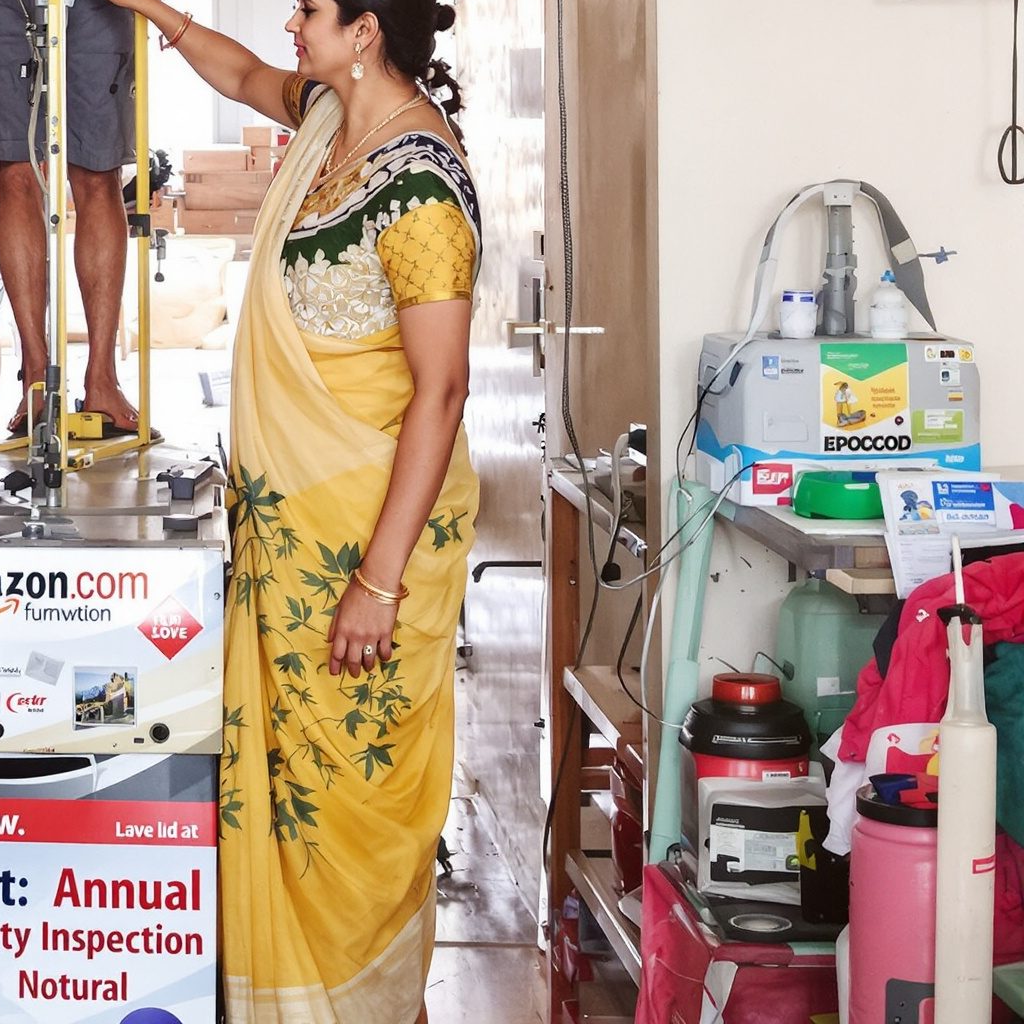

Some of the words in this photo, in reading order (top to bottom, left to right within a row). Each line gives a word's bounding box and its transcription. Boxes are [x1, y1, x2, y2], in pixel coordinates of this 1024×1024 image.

[115, 821, 154, 838] Lave
[53, 868, 201, 911] Annual
[41, 922, 203, 960] Inspection
[18, 970, 128, 1001] Notural
